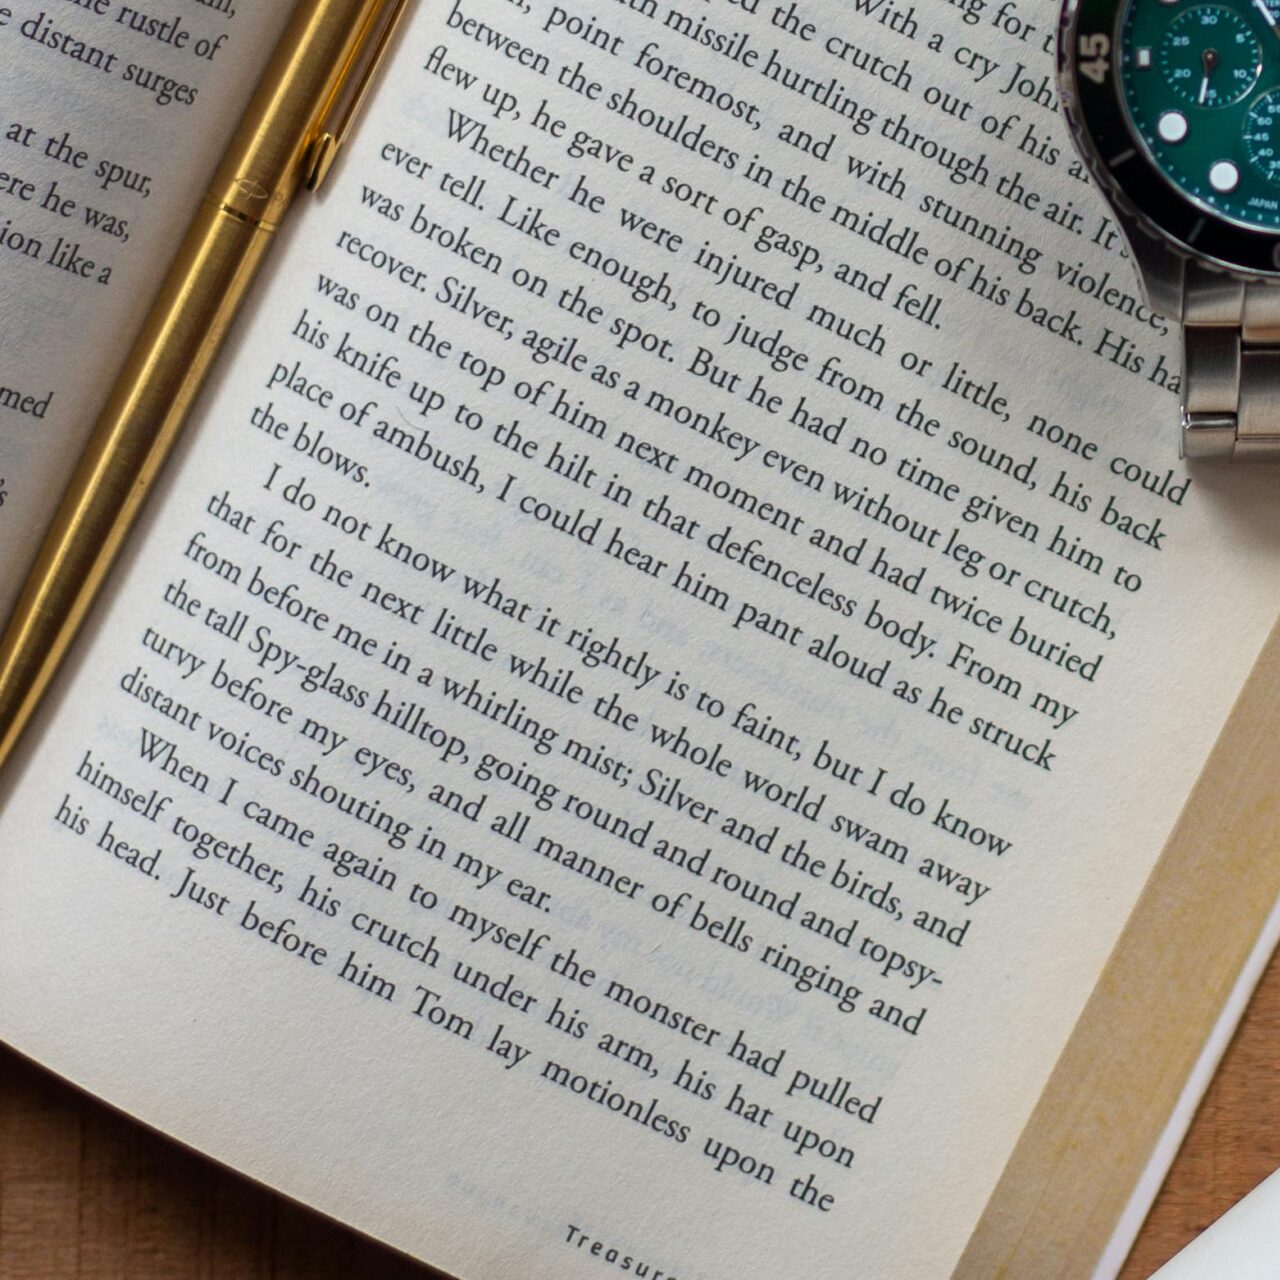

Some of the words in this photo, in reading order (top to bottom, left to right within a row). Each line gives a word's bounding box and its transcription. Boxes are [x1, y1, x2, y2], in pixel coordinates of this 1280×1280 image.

[19, 11, 119, 74] distant
[121, 63, 199, 107] surges
[1079, 33, 1112, 84] 45
[1201, 15, 1218, 25] 30
[1233, 69, 1247, 78] 10
[5, 123, 37, 148] at
[44, 132, 89, 169] the
[94, 160, 152, 199] spur,
[423, 44, 479, 91] flew
[482, 83, 521, 121] up,
[529, 99, 567, 139] he
[566, 130, 634, 173] gave
[638, 165, 656, 186] a
[661, 176, 719, 216] sort
[722, 206, 765, 233] of
[753, 225, 824, 274] gasp,
[833, 263, 893, 302] and
[892, 283, 943, 330] fell.
[1248, 196, 1278, 210] JAPAN
[361, 185, 405, 222] was
[409, 203, 503, 275] broken
[511, 268, 549, 299] on
[557, 285, 604, 325] the
[609, 317, 674, 363] spot.
[686, 346, 742, 394] But
[745, 375, 784, 414] he
[787, 396, 848, 445] had
[848, 436, 888, 466] no
[896, 457, 961, 502] time
[961, 494, 1040, 544] given
[1045, 524, 1104, 576] him
[1113, 566, 1142, 593] to
[250, 401, 290, 441] the
[292, 421, 370, 488] blows.
[262, 462, 283, 491] I
[282, 476, 316, 512] do
[321, 505, 373, 542] not
[374, 522, 457, 583] know
[463, 575, 533, 624] what
[534, 607, 562, 638] it
[564, 627, 662, 691] rightly
[663, 670, 690, 702] is
[695, 691, 725, 719] to
[730, 702, 802, 762] faint,
[812, 739, 864, 787] but
[866, 767, 889, 797] I
[889, 781, 926, 816] do
[931, 798, 1014, 857] know
[53, 793, 90, 836] his
[96, 820, 163, 881] head.
[169, 866, 231, 916] Just
[239, 899, 328, 966] before
[336, 950, 396, 1003] him
[411, 984, 474, 1041] Tom
[485, 1024, 532, 1071] lay
[539, 1060, 692, 1144] motionless
[702, 1137, 775, 1186] upon
[789, 1173, 835, 1213] the
